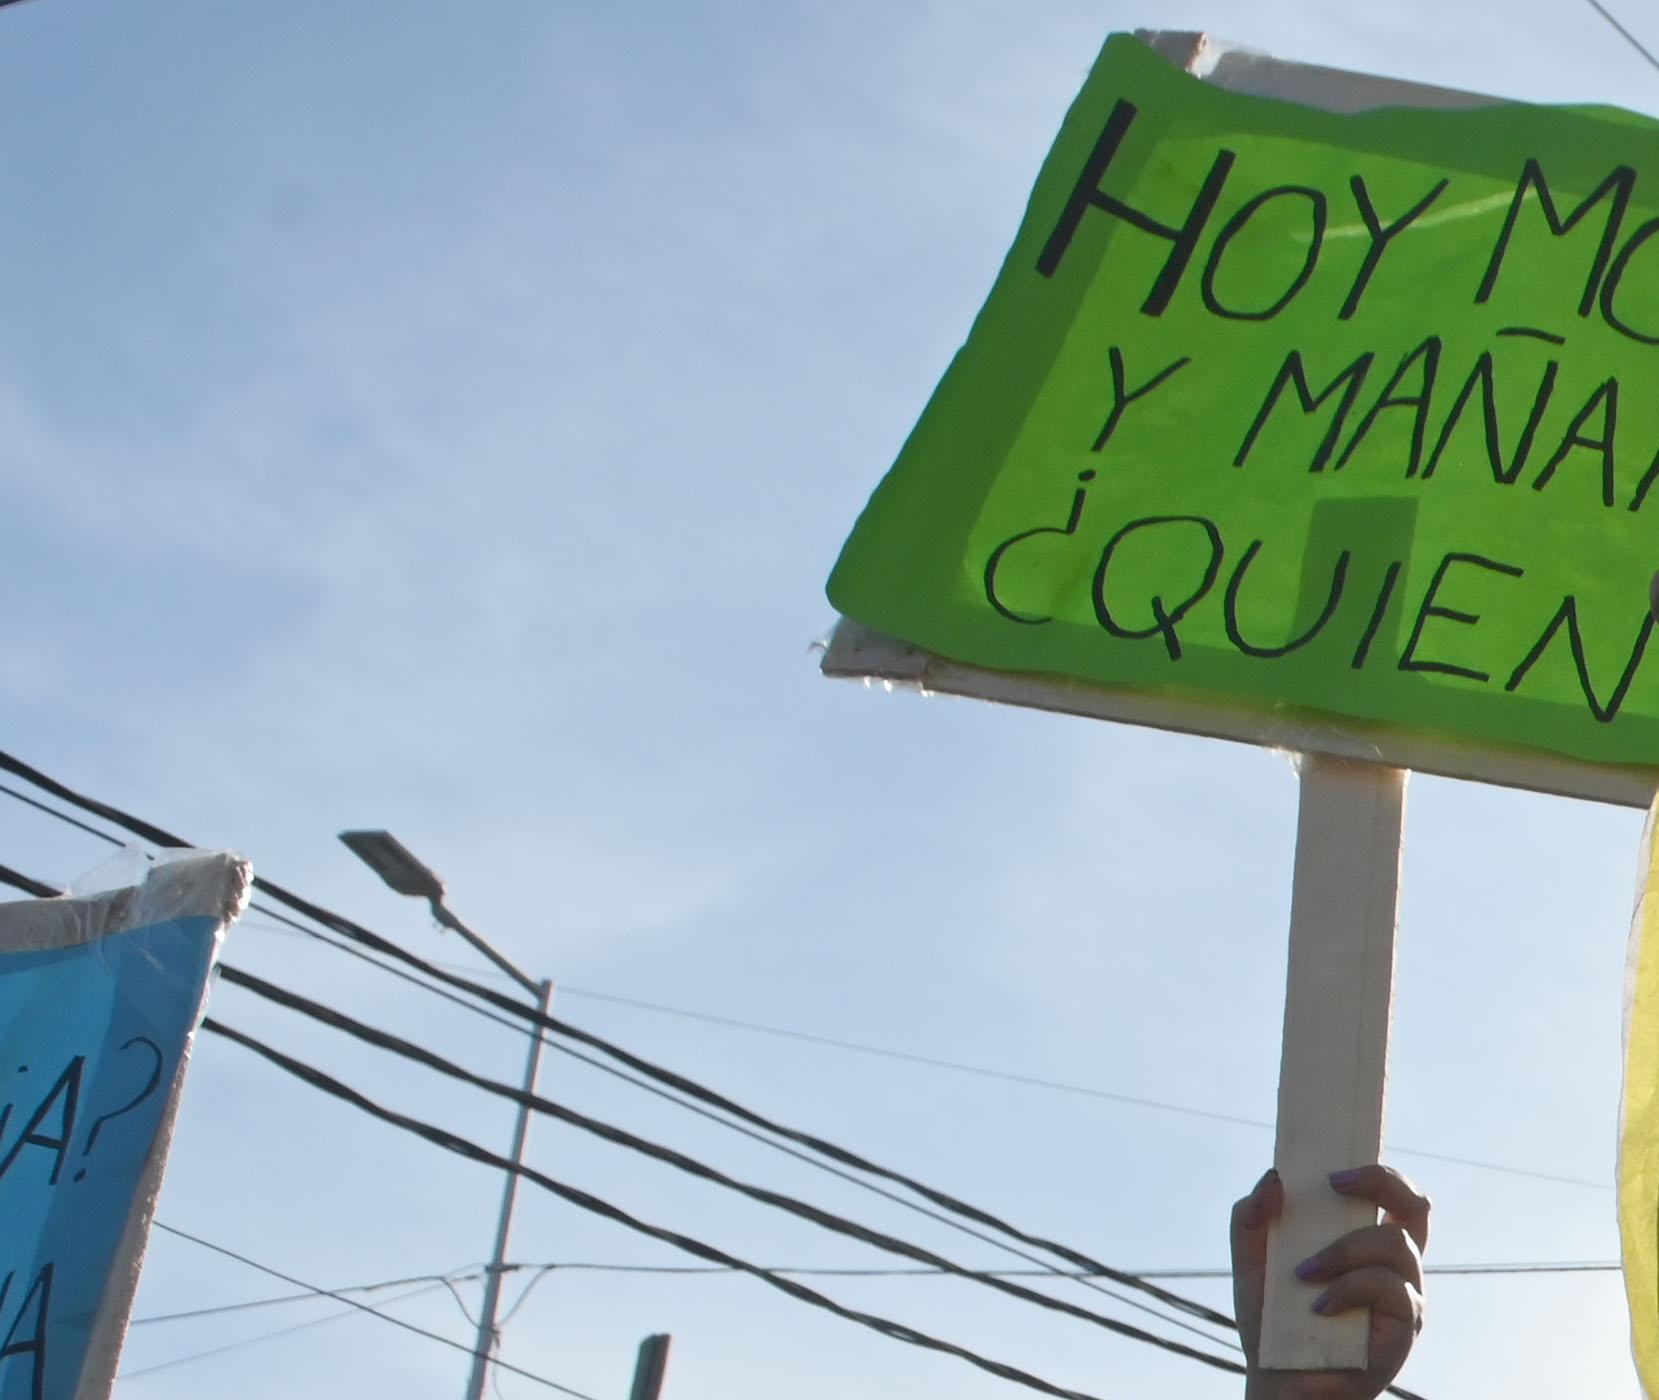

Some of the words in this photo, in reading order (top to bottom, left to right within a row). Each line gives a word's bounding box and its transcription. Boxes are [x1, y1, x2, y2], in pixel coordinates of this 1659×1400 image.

[1034, 98, 1449, 322] HOY
[1091, 346, 1191, 453] Y
[0, 1036, 164, 1187] A?
